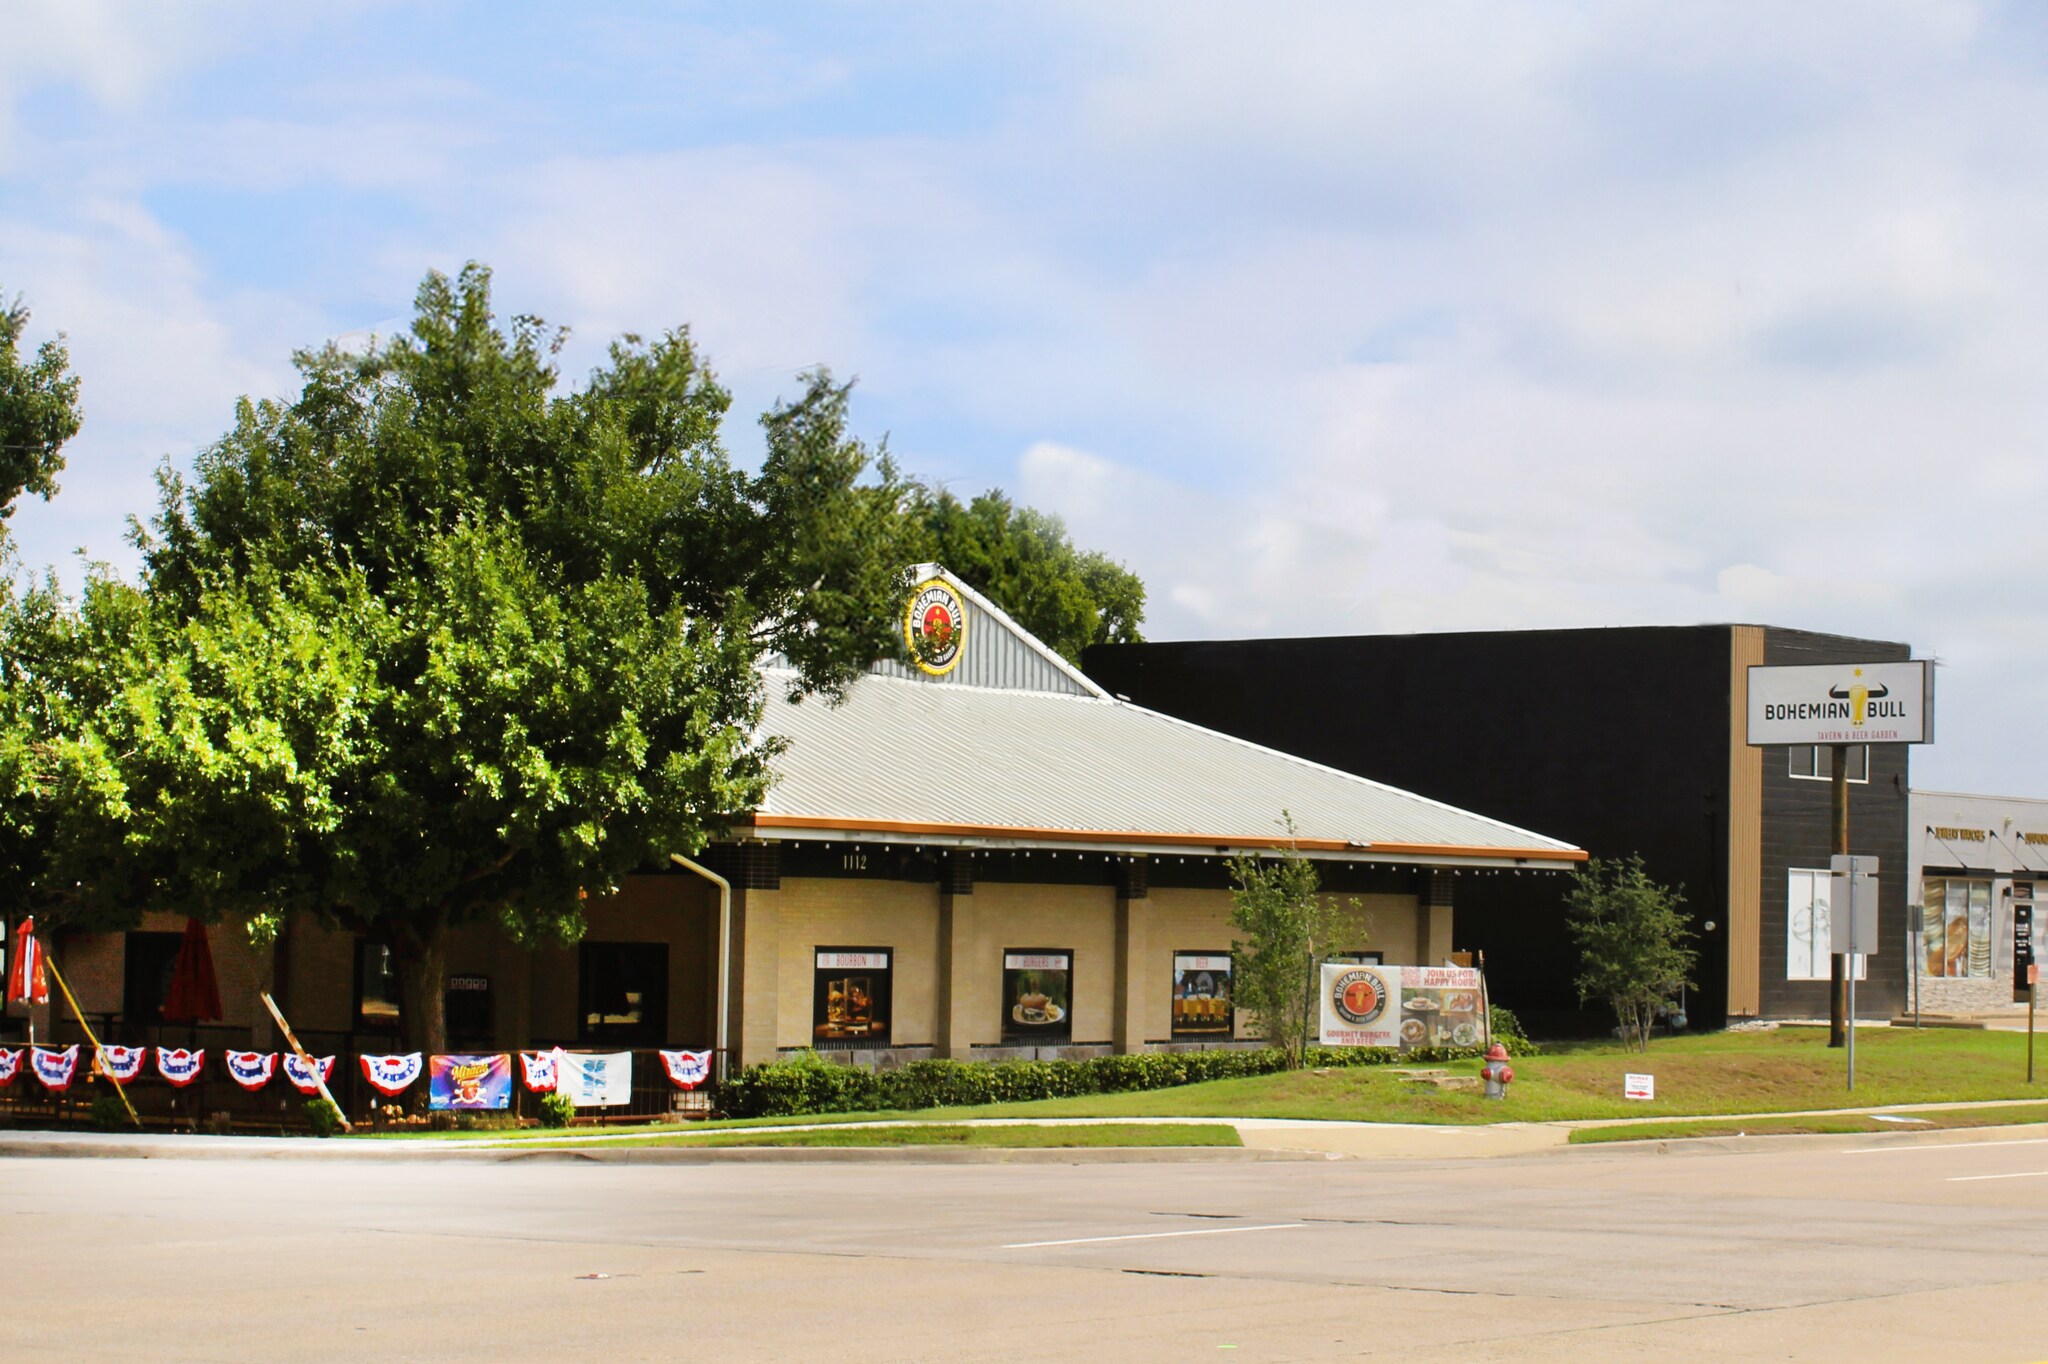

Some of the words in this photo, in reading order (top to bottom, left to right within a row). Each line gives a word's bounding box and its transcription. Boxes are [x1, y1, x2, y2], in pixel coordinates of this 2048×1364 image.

[913, 590, 950, 628] BOHEMIAN
[1765, 702, 1849, 720] BOHEMIAN
[1867, 701, 1906, 718] BULL
[1818, 731, 1842, 740] TAVERN
[1852, 730, 1869, 740] BEER
[1871, 730, 1898, 739] GARDEN
[844, 855, 867, 870] 1112
[836, 954, 867, 967] BOURBON
[1427, 969, 1445, 978] JOIN
[1446, 969, 1457, 978] US
[1458, 970, 1474, 978] FOR
[1334, 972, 1372, 999] BOHEMIAN
[1370, 977, 1385, 999] BULL
[1424, 977, 1450, 987] HAPPY
[1451, 978, 1477, 988] HOUR!
[1327, 1030, 1358, 1038] GOURMET
